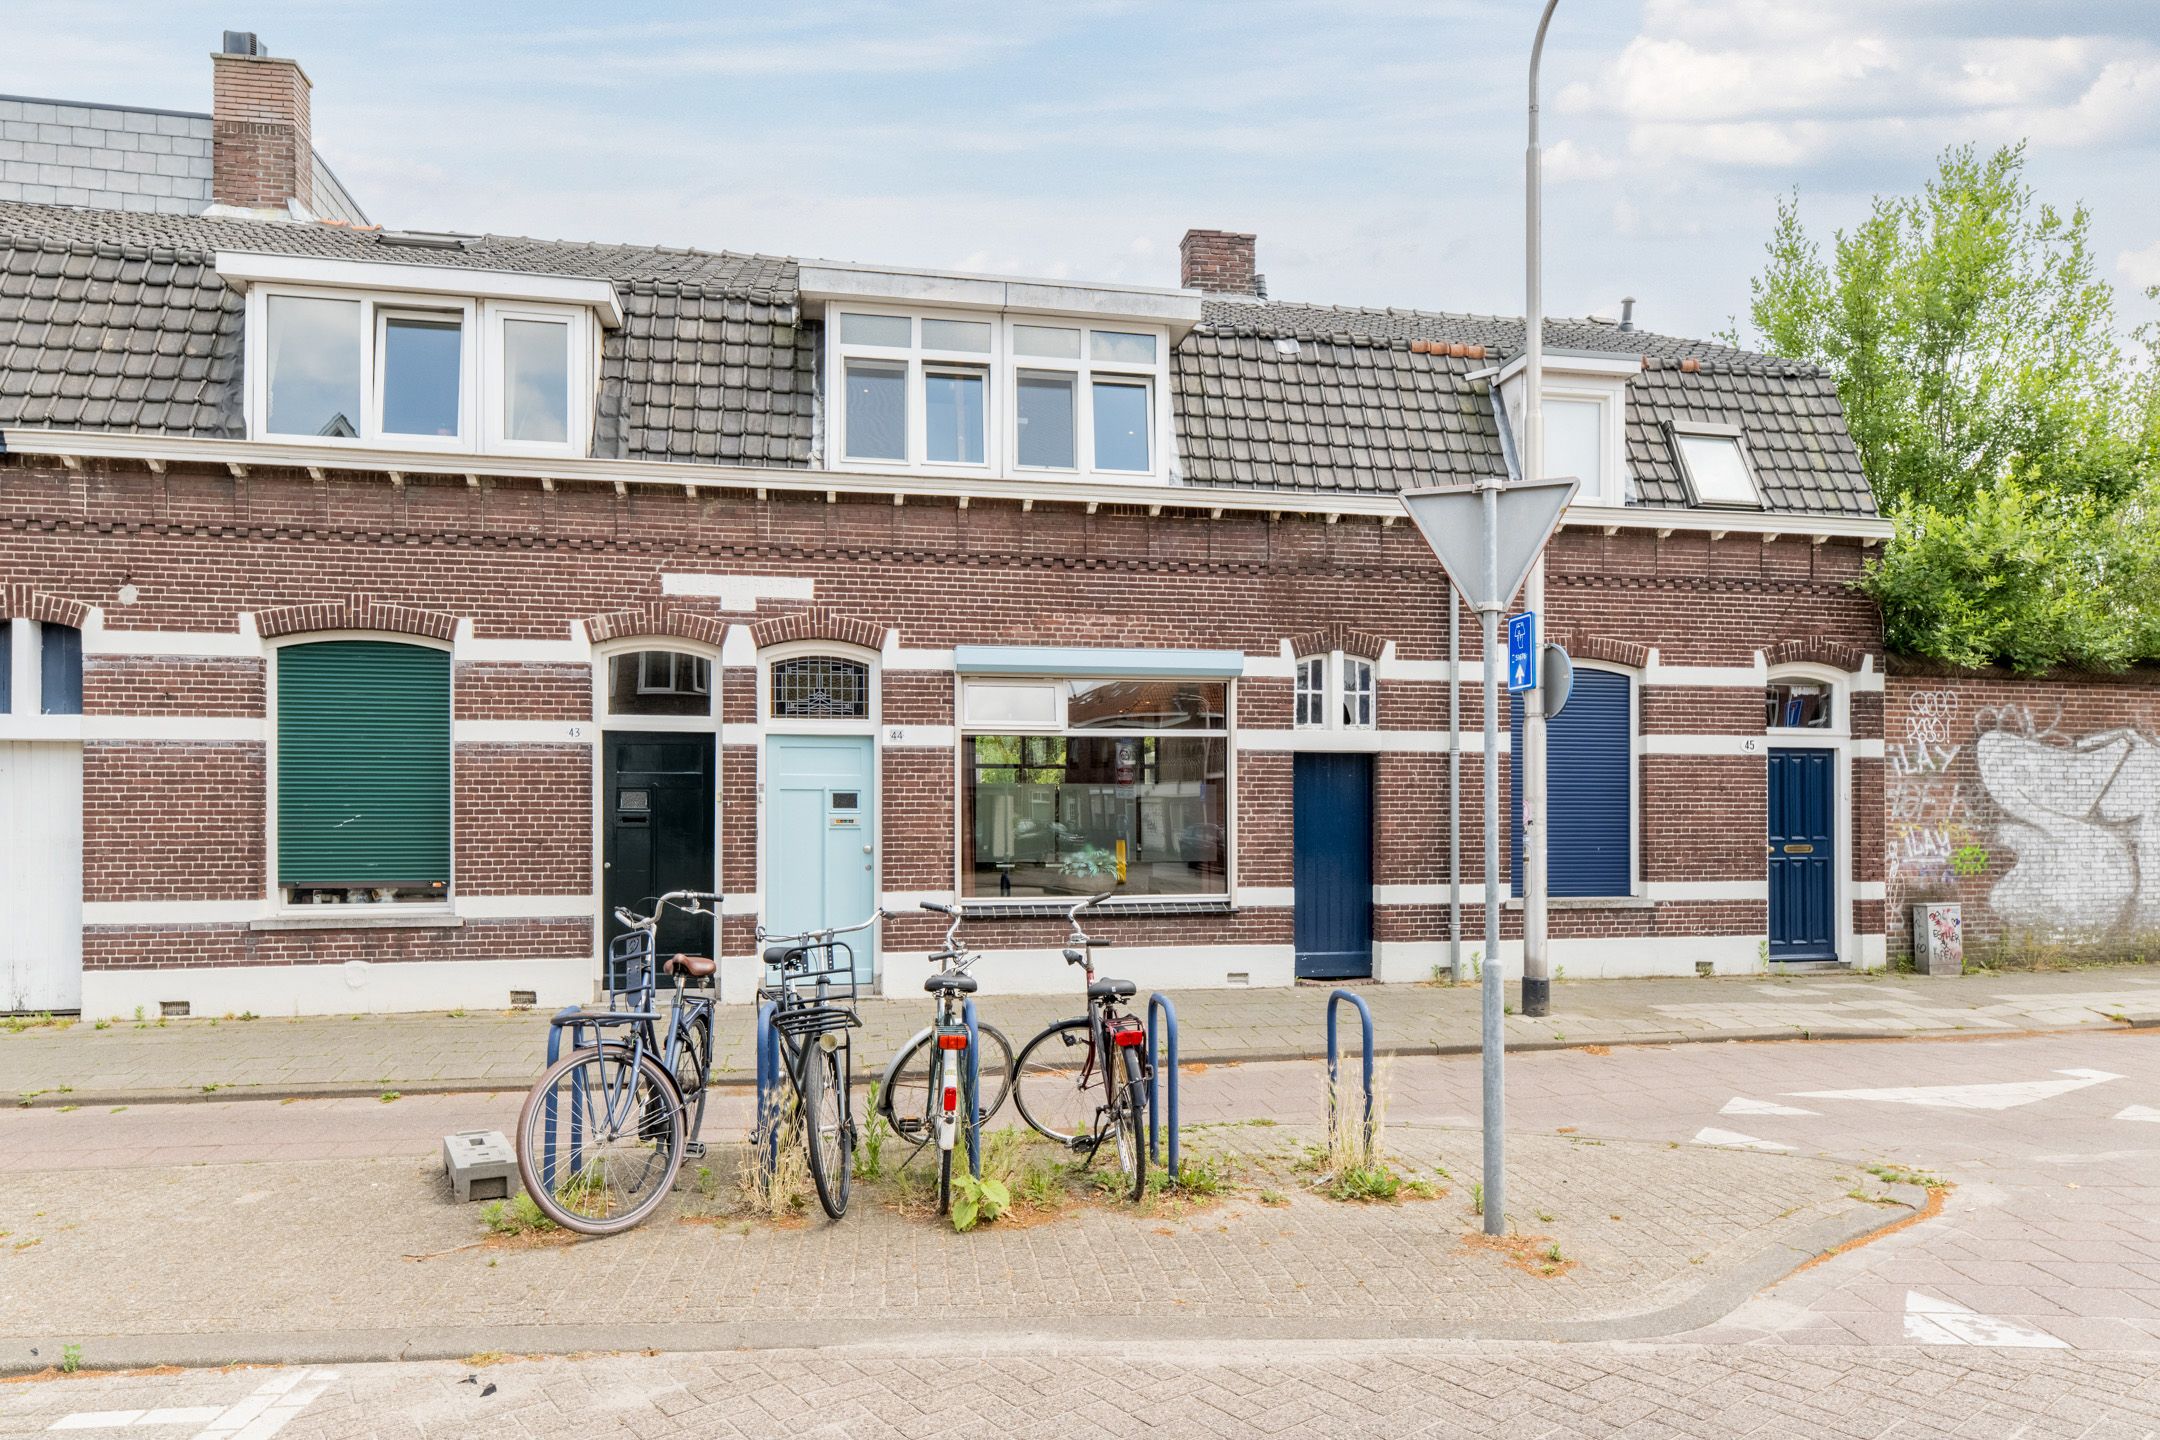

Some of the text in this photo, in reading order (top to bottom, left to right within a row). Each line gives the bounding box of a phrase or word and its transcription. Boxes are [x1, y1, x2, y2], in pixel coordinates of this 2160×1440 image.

[568, 727, 581, 738] 43
[890, 730, 904, 740] 44
[1744, 740, 1755, 750] 45
